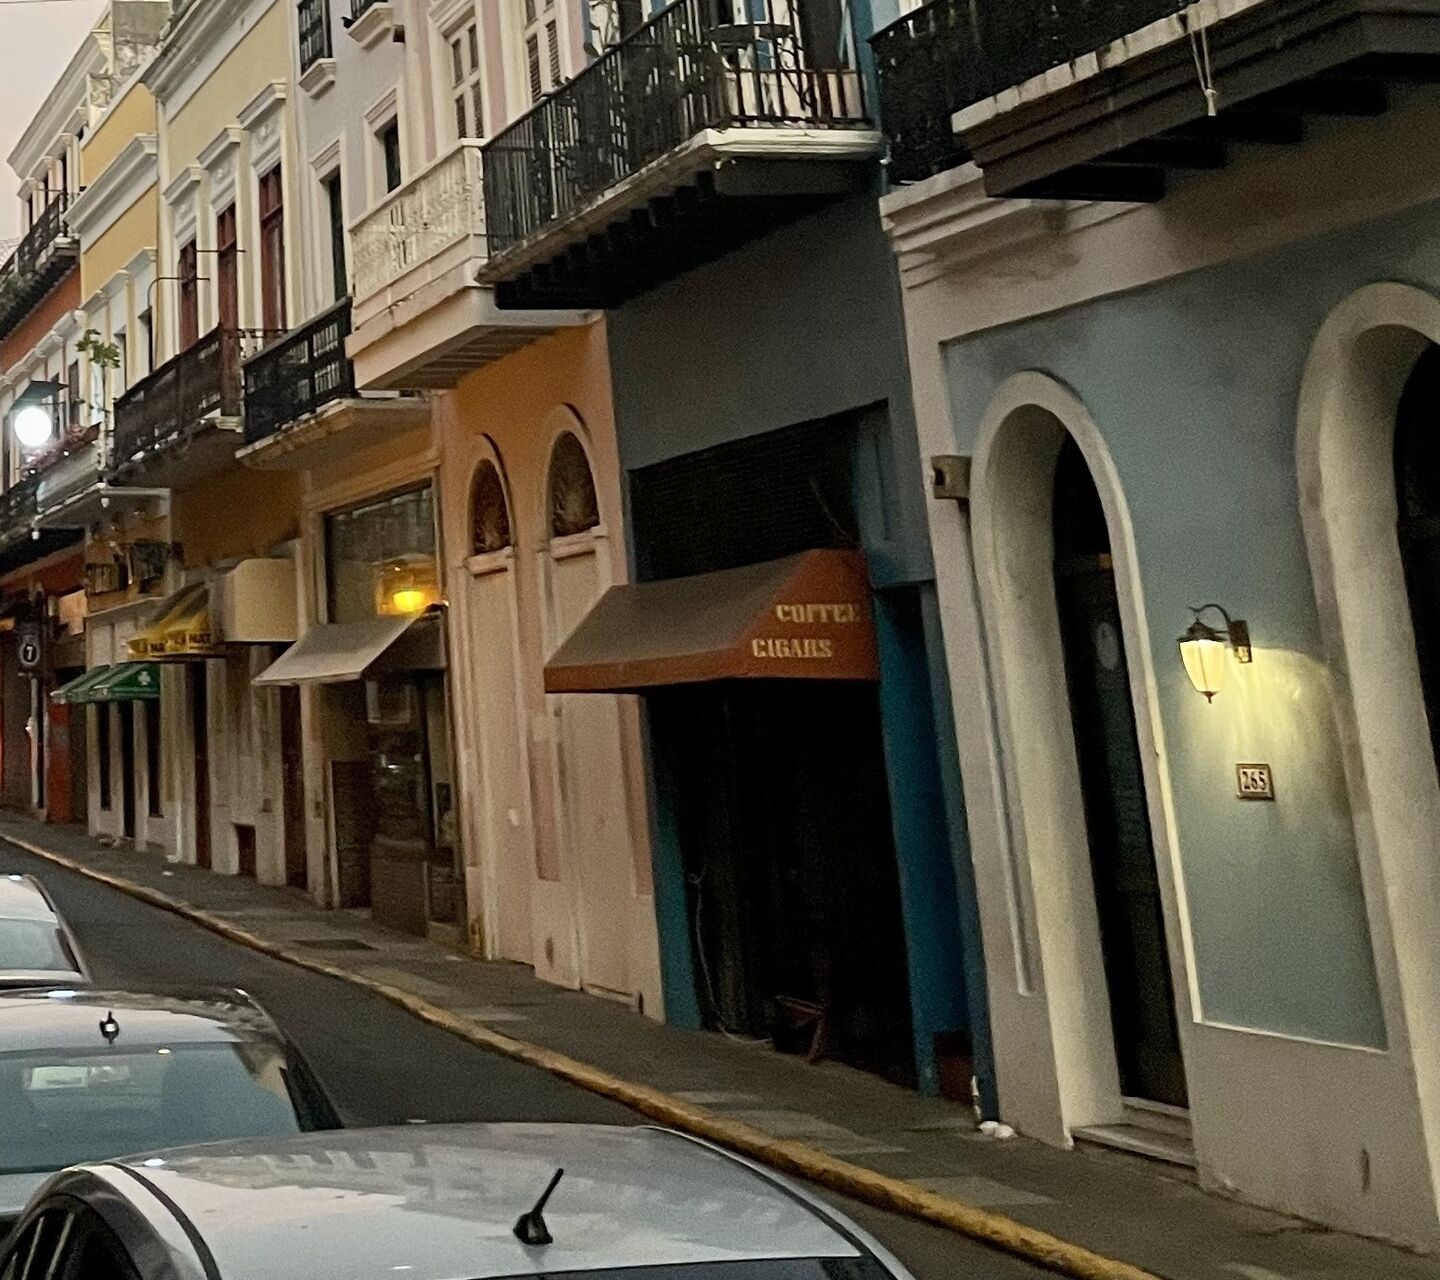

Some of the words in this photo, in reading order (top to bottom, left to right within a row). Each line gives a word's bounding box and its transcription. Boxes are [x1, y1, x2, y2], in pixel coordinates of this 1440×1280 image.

[775, 603, 862, 623] COFFEE
[751, 638, 832, 658] CIGARS
[1242, 770, 1267, 791] 265
